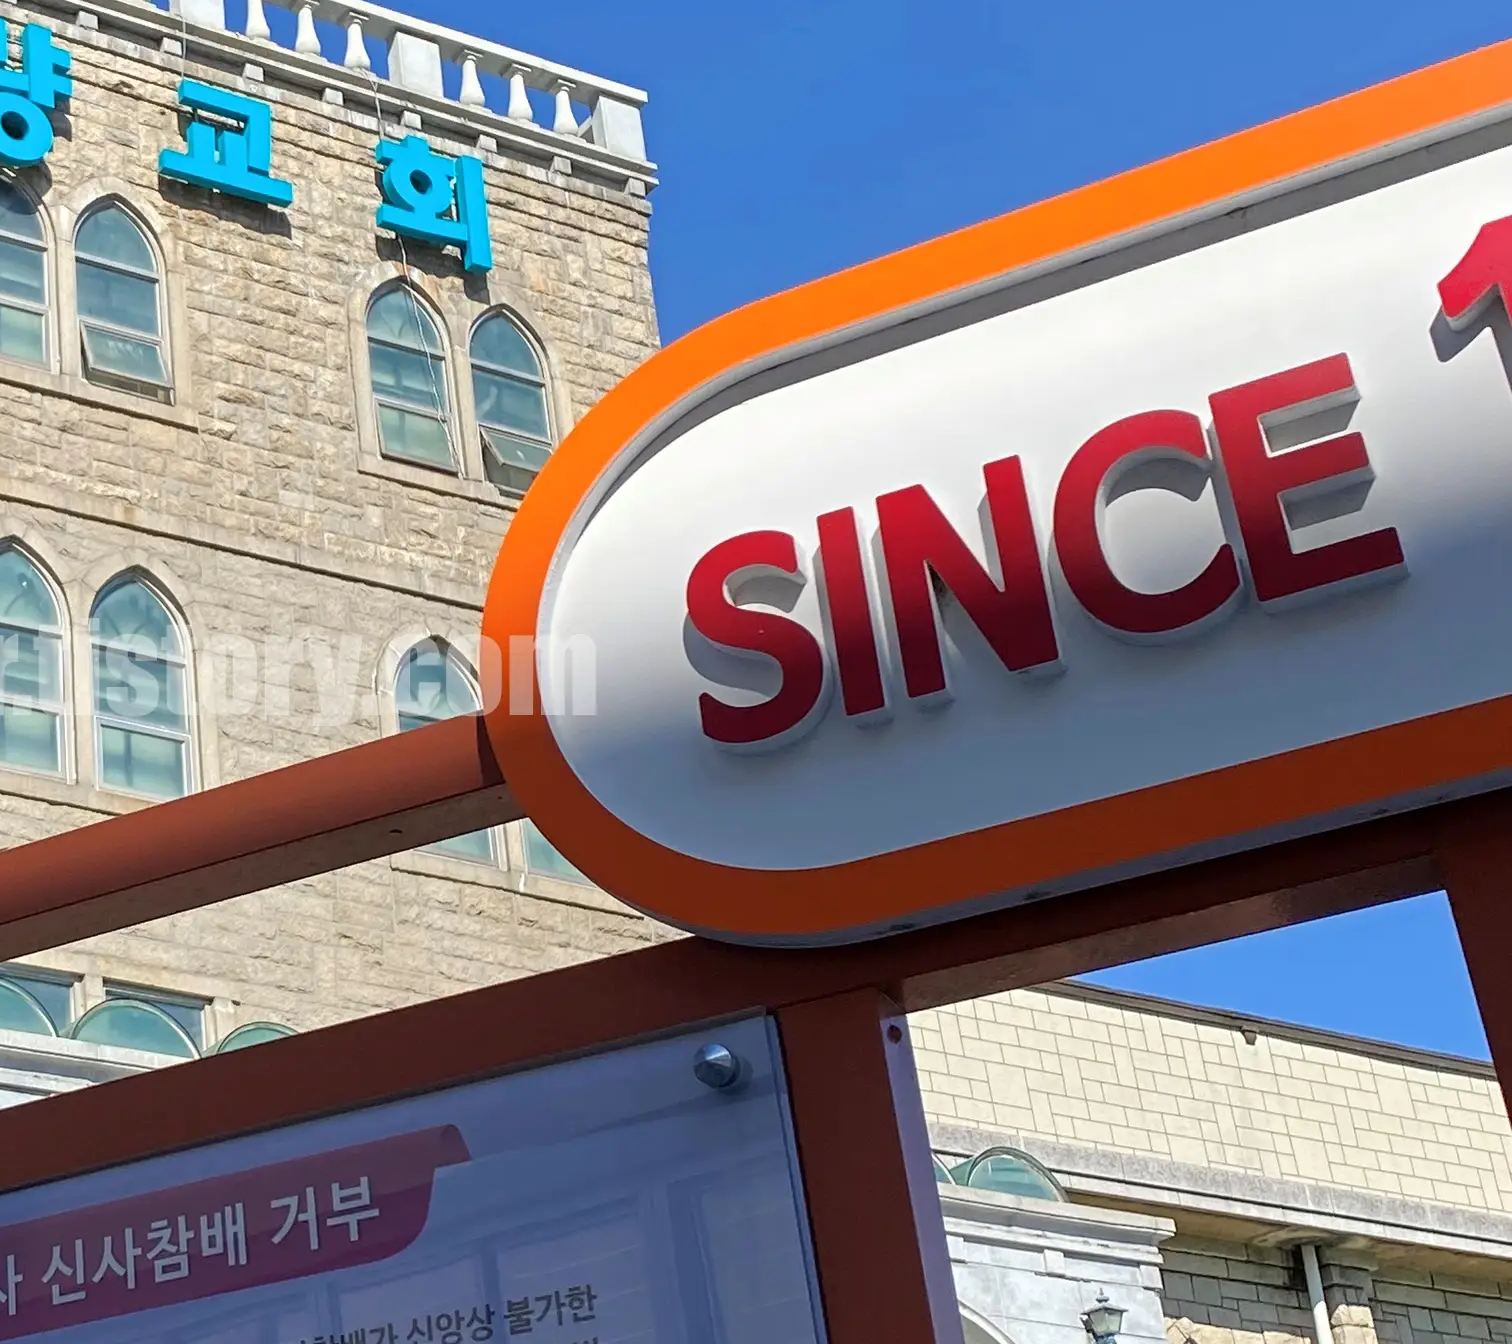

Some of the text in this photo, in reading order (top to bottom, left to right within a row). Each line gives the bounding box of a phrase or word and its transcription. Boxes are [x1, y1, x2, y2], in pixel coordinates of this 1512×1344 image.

[687, 352, 1406, 747] SINCE
[40, 1209, 250, 1304] 신사참배
[270, 1176, 382, 1253] 거부
[503, 1284, 598, 1335] 불가한
